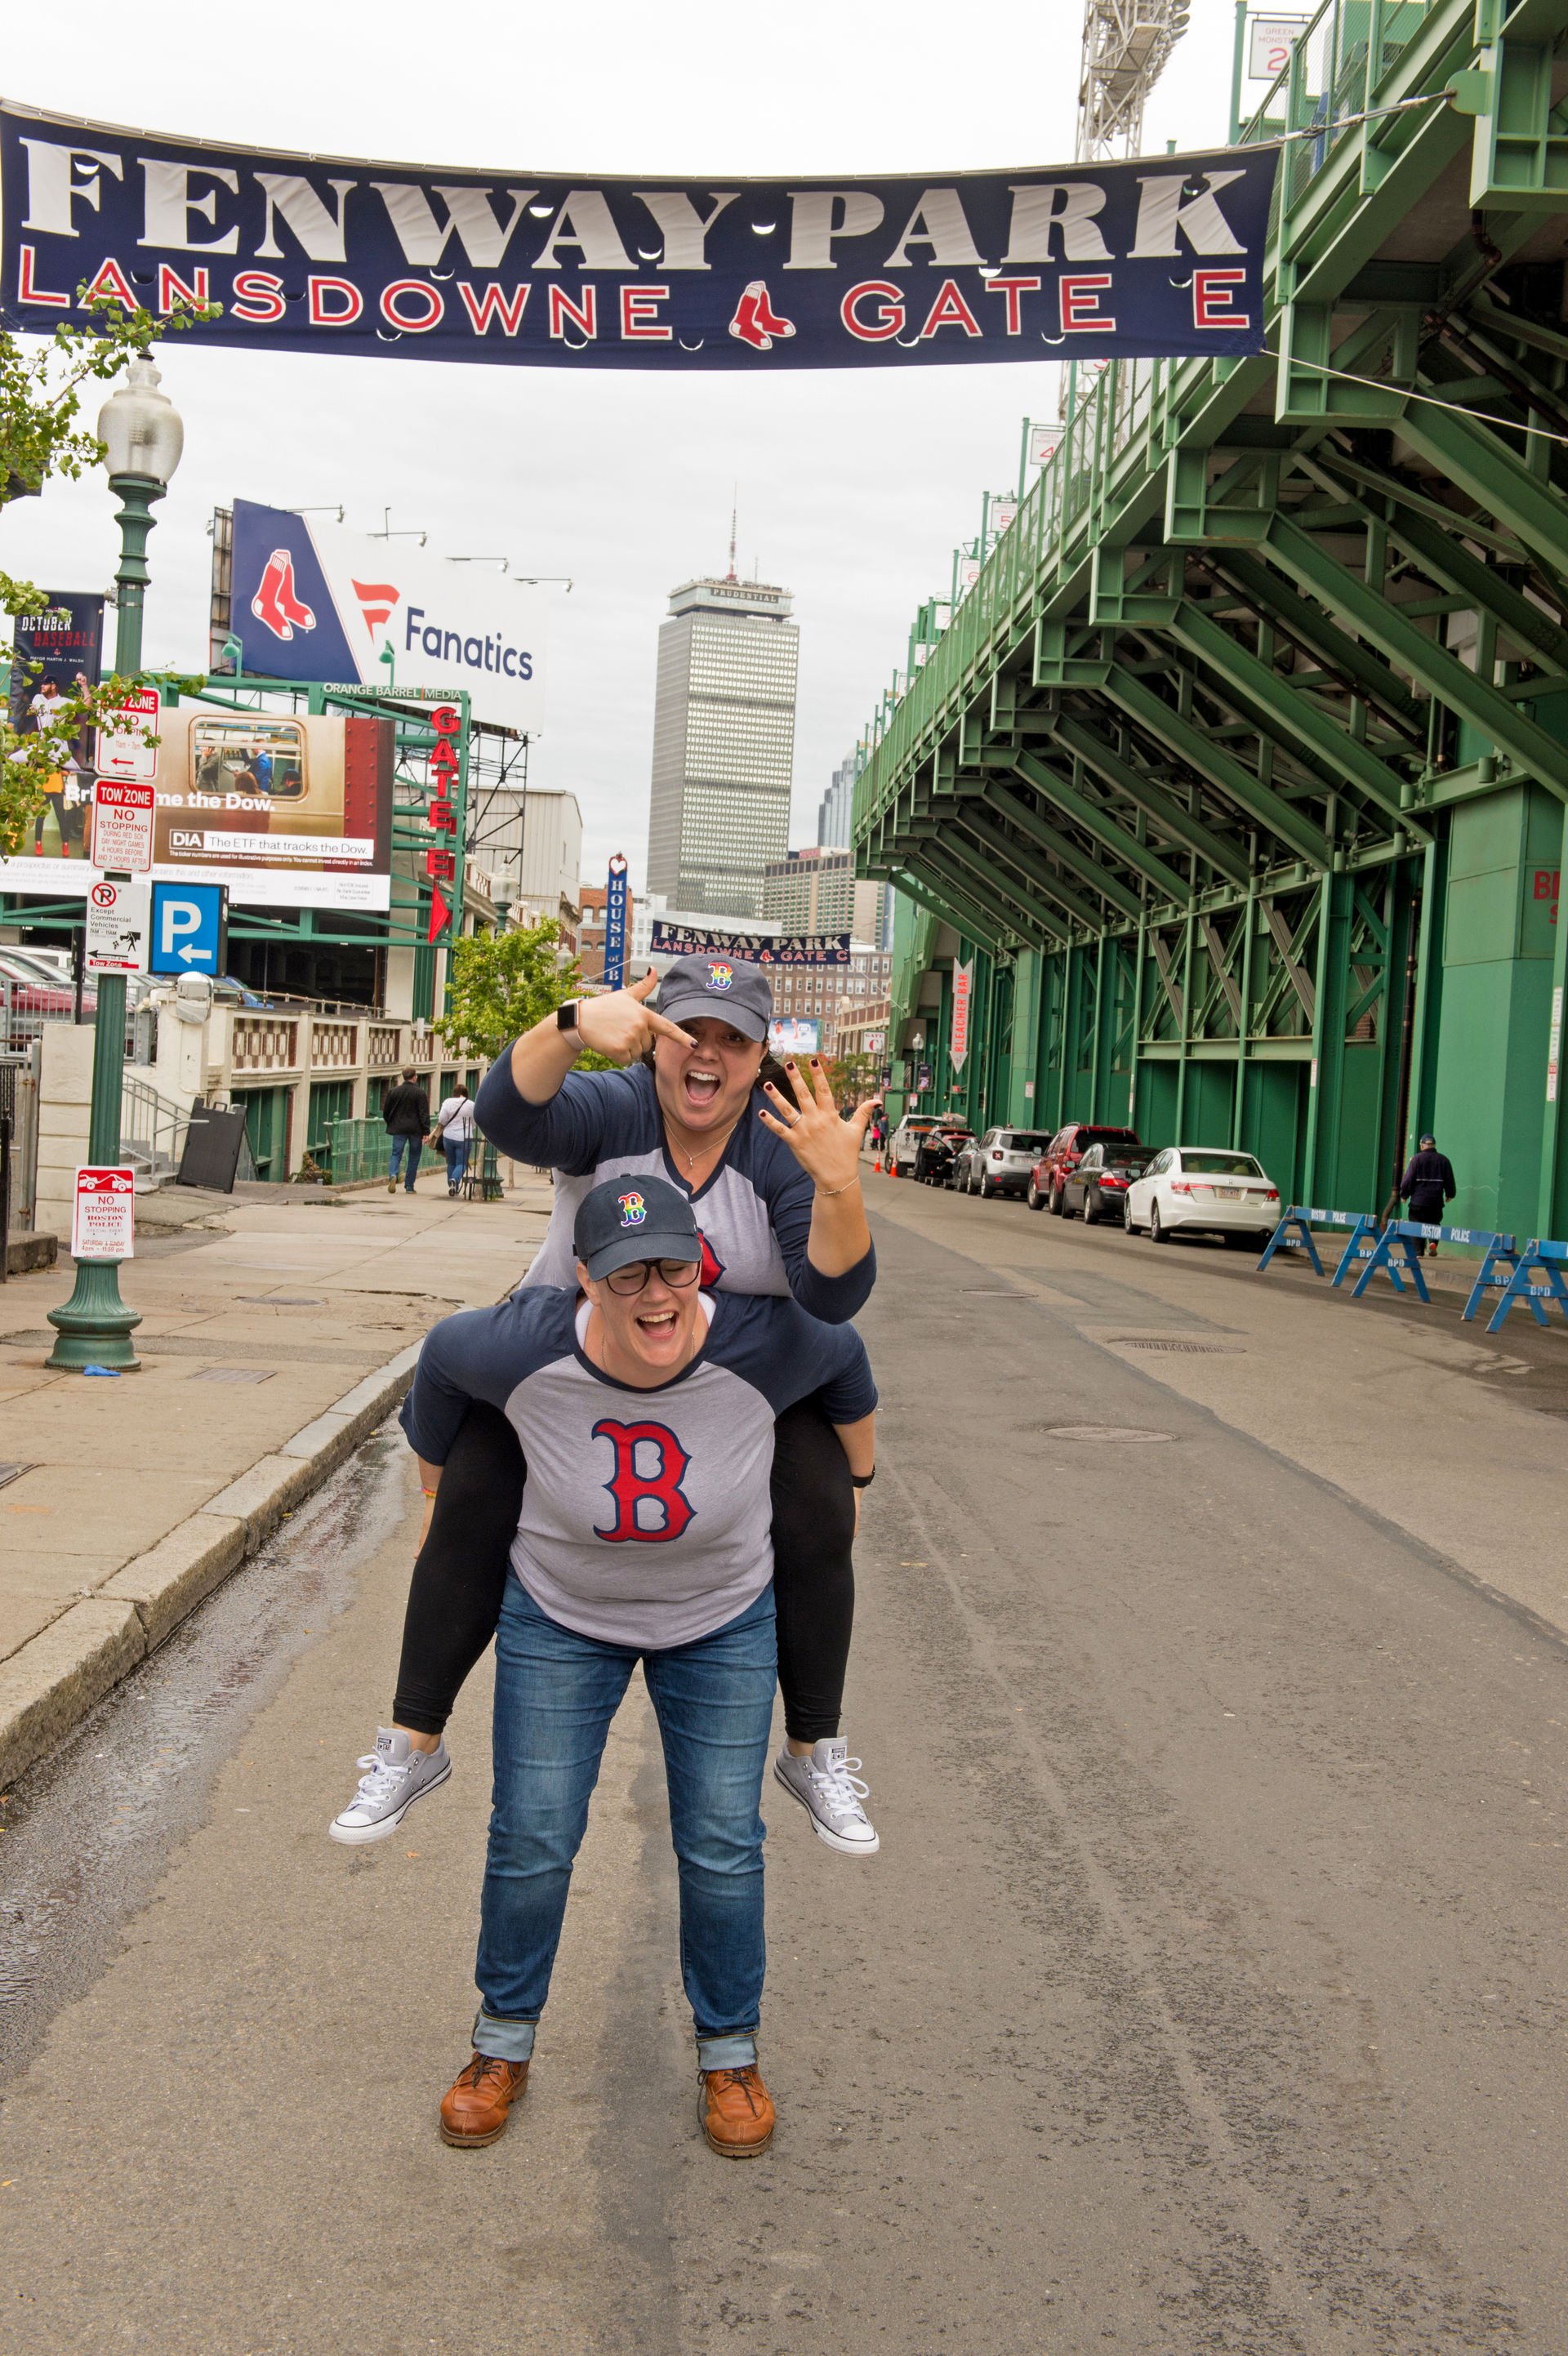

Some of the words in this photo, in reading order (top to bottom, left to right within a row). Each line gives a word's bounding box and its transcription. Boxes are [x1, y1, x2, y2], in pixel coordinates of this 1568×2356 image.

[1265, 27, 1294, 35] GREEN
[1267, 47, 1288, 71] 2
[19, 136, 742, 270] FENWAY
[782, 168, 1249, 269] PARK
[17, 243, 673, 341] LANSDOWNE
[840, 272, 1117, 342] GATE
[1192, 267, 1250, 330] E
[1040, 446, 1054, 457] 4
[1000, 515, 1012, 529] 5
[713, 588, 777, 603] PRUDENTIAL
[21, 616, 73, 631] OCTOBER
[33, 631, 96, 647] BASEBALL
[406, 606, 533, 681] Fanatics
[323, 682, 373, 696] ORANGE
[376, 685, 420, 698] BARREL
[425, 688, 462, 701] MEDIA
[118, 713, 140, 726] NO
[428, 706, 461, 829] GATE
[65, 784, 94, 802] Bri
[156, 793, 184, 807] me
[188, 791, 221, 808] the
[225, 792, 276, 811] Dow.
[100, 786, 123, 803] TOW
[124, 789, 151, 806] ZONE
[113, 808, 136, 822] NO
[100, 820, 149, 833] STOPPING
[103, 830, 122, 838] DURING
[172, 831, 202, 848] DIA
[209, 836, 231, 848] The
[234, 837, 256, 848] ETF
[259, 840, 280, 850] that
[283, 841, 318, 853] tracks
[320, 842, 339, 853] the
[341, 843, 369, 855] Dow.
[114, 856, 131, 864] HOURS
[426, 847, 450, 875] E
[91, 906, 115, 915] Except
[608, 880, 624, 948] HOUSE
[90, 914, 131, 924] Commercial
[90, 921, 119, 929] Vehicles
[162, 900, 203, 954] P
[660, 923, 767, 951] FENWAY
[771, 935, 844, 951] PARK
[653, 938, 755, 960] LANSDOWNE
[780, 950, 827, 962] GATE
[836, 950, 848, 961] C
[607, 953, 620, 963] of
[706, 962, 733, 991] B
[957, 973, 968, 994] BAR
[954, 999, 967, 1053] BLEACHER
[97, 1196, 114, 1205] NO
[617, 1191, 648, 1227] B
[1311, 1209, 1326, 1221] BOSTON
[1332, 1210, 1347, 1224] POLICE
[1421, 1223, 1442, 1240] BOSTON
[1450, 1227, 1471, 1244] POLICE
[82, 1238, 104, 1246] SATURDAY
[1285, 1238, 1301, 1247] BPD
[1388, 1258, 1405, 1267] BPD
[1494, 1275, 1510, 1285] BP
[1530, 1285, 1551, 1297] BPD
[591, 1418, 699, 1543] B
